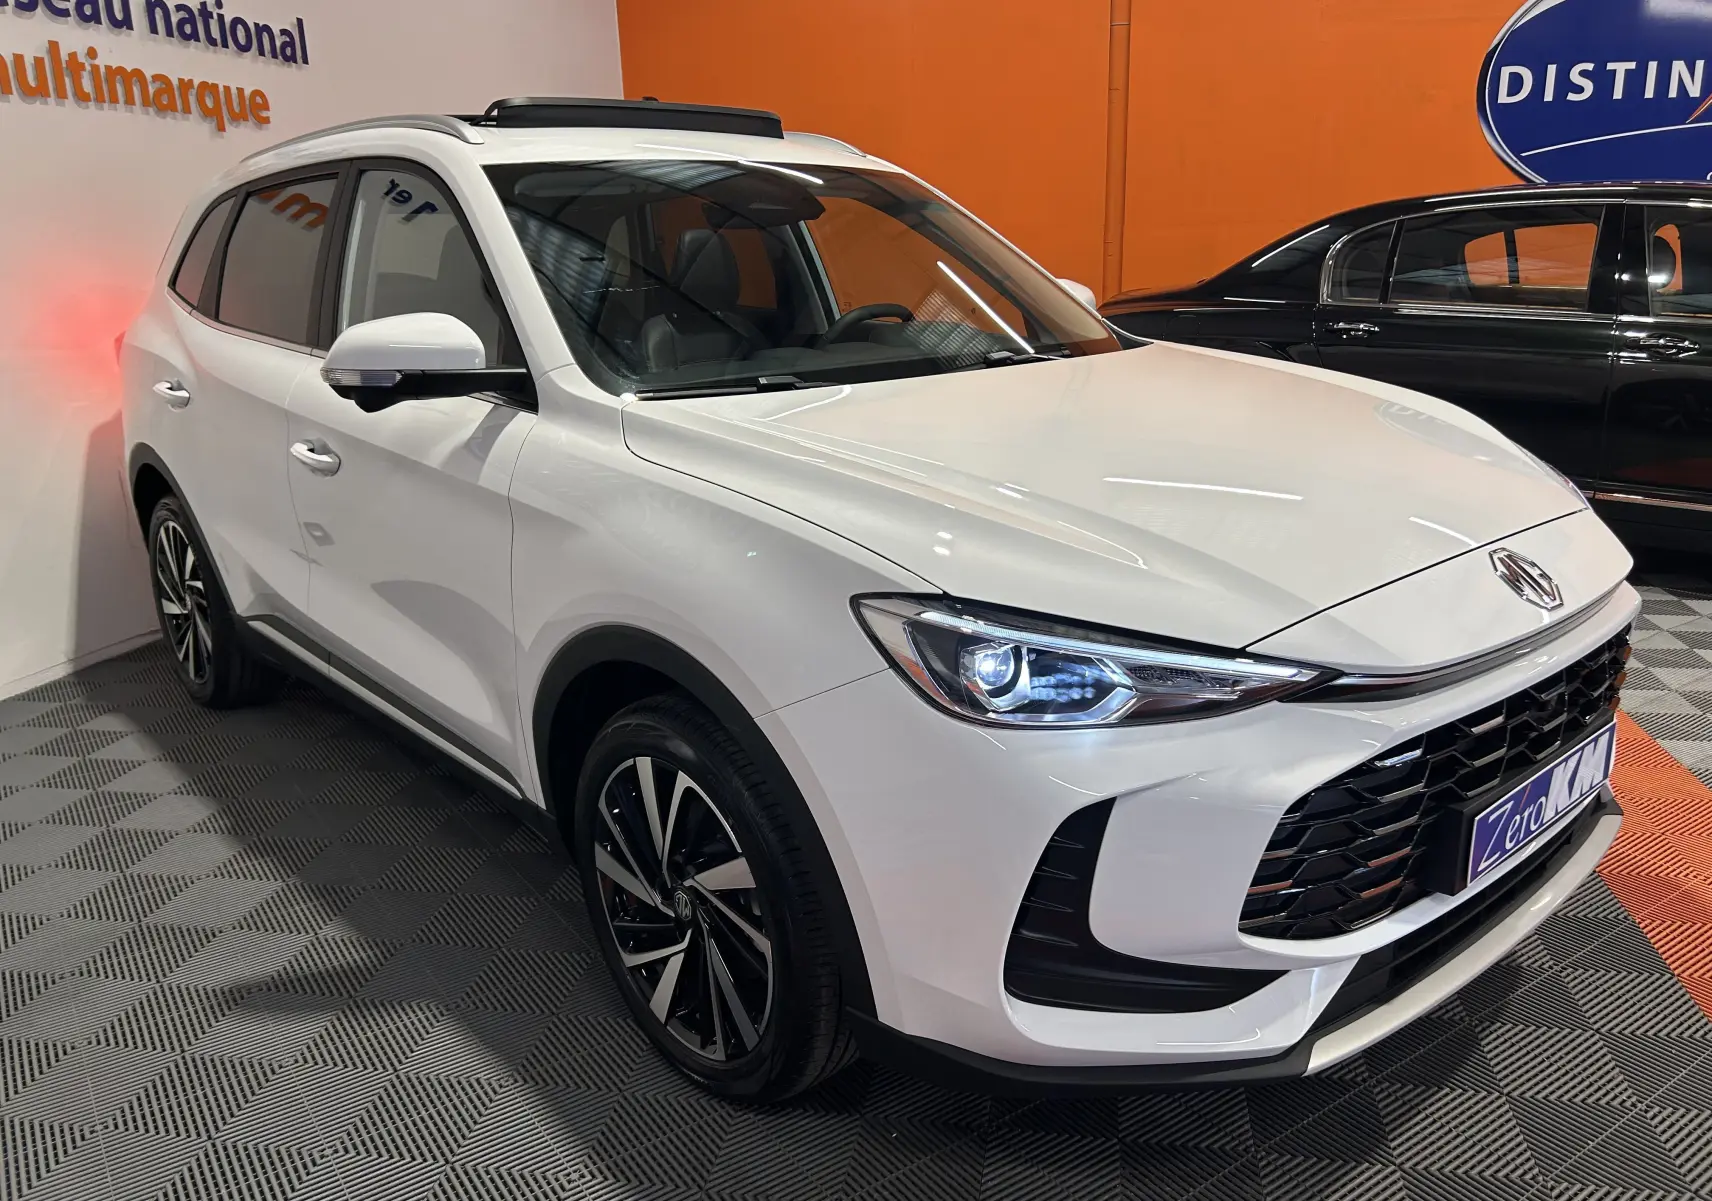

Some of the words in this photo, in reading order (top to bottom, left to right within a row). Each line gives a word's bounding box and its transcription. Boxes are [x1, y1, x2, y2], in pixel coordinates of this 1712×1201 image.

[145, 0, 309, 65] national
[1497, 60, 1705, 104] DISTIN
[1491, 549, 1561, 609] MG
